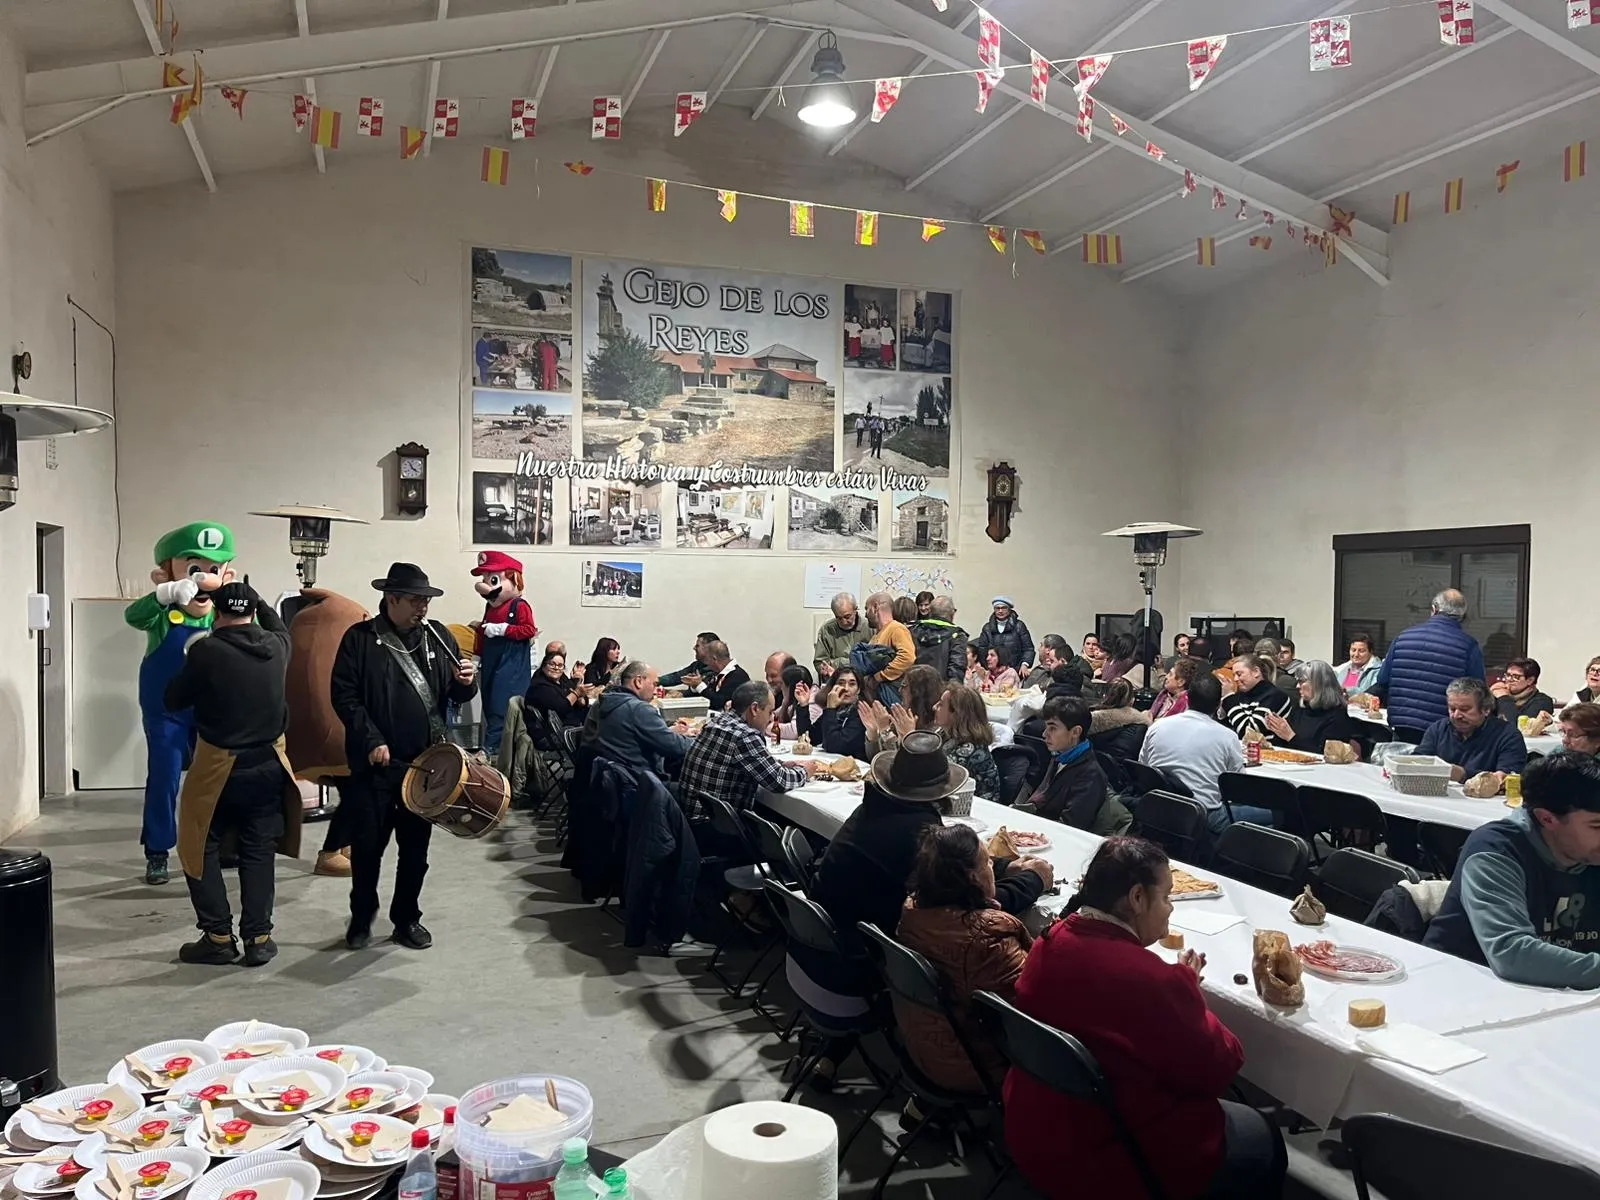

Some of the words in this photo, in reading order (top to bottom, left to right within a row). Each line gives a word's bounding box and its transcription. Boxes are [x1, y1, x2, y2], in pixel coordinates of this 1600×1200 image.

[623, 268, 710, 310] GEJO
[720, 285, 764, 313] DE
[774, 290, 829, 319] LOS
[649, 314, 749, 355] REYES
[516, 451, 600, 479] Nuestra
[605, 455, 688, 482] Historia
[689, 466, 709, 491] y
[709, 460, 823, 486] Costrumbres
[825, 471, 877, 490] están
[880, 465, 929, 491] Vivas
[204, 531, 216, 547] L
[228, 598, 248, 606] PIPE
